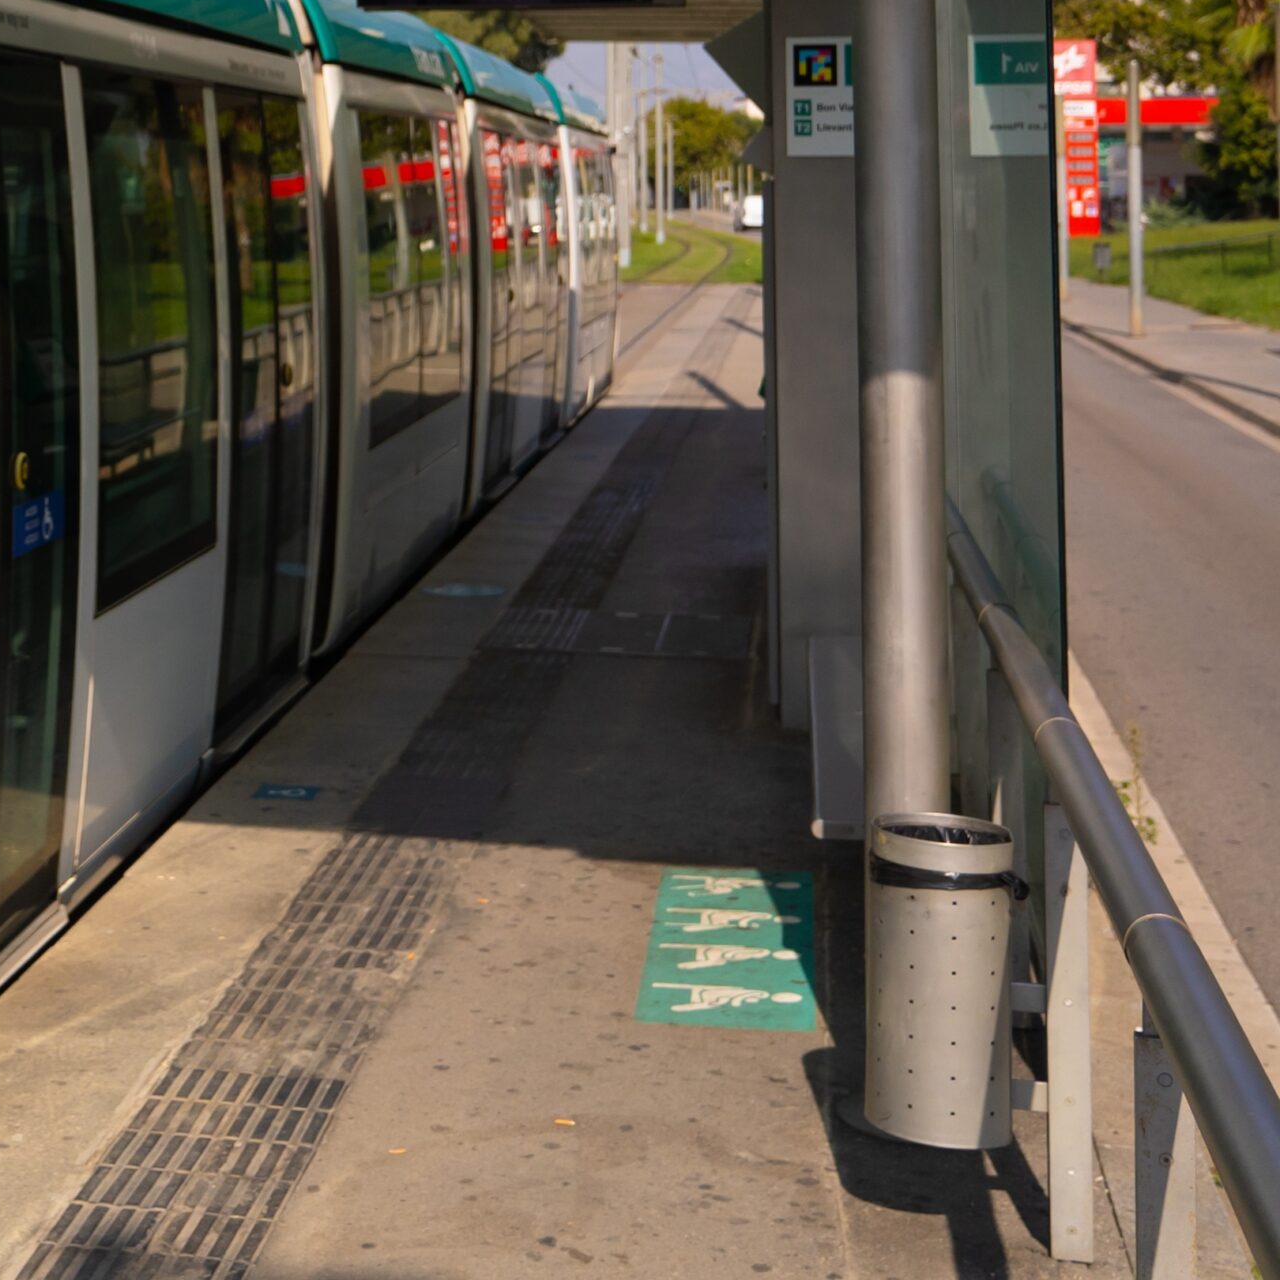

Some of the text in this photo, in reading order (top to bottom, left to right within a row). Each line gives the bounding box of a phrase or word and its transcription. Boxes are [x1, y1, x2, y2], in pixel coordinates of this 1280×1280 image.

[795, 102, 854, 114] T1 Bon Via
[796, 122, 811, 134] T2
